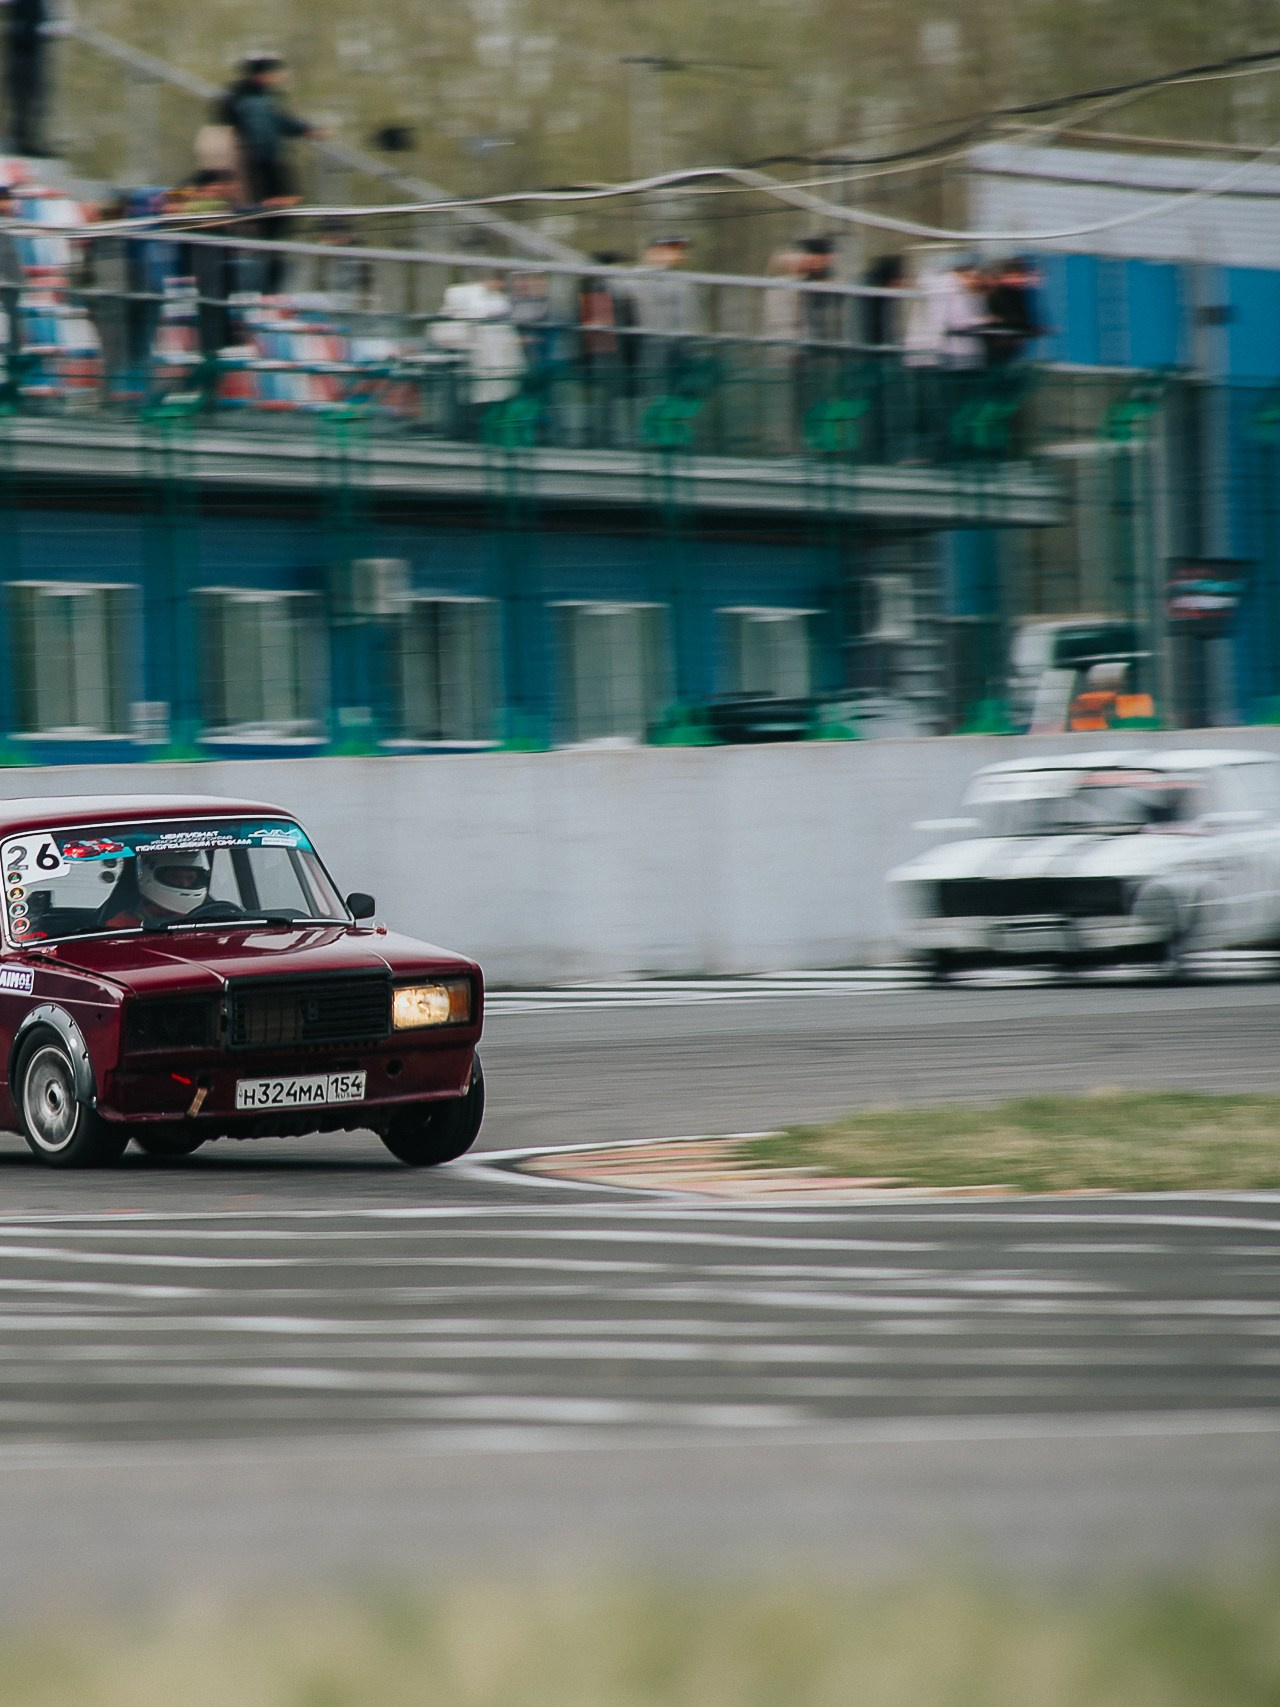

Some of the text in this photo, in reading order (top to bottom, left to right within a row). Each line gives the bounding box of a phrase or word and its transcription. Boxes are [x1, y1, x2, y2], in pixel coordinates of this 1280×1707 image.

[7, 843, 60, 870] 26
[0, 970, 31, 989] AIMOL
[244, 1075, 362, 1106] Н324МА 154
